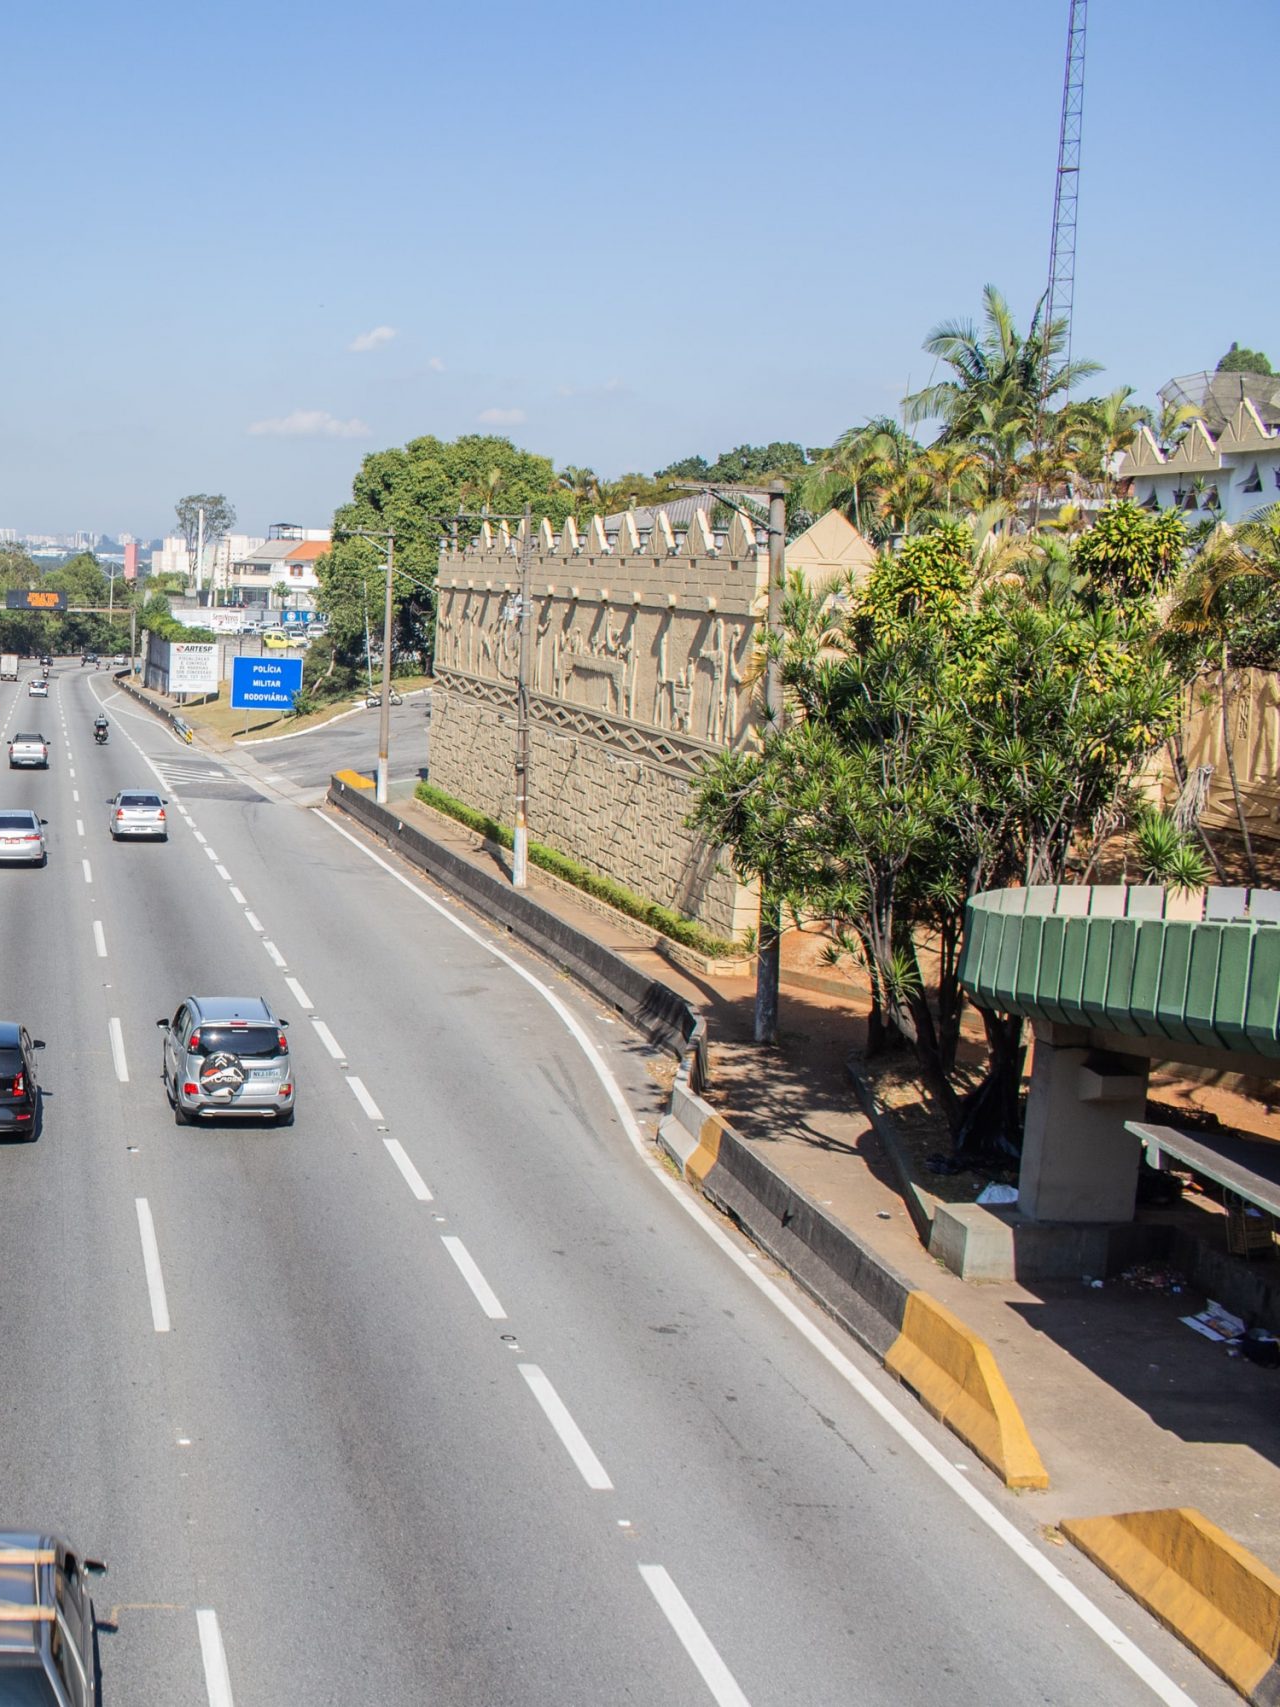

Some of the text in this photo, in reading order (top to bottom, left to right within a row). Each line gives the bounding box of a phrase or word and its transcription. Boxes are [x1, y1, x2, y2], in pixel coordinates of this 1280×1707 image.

[253, 664, 282, 673] POLÍCIA
[253, 680, 281, 688] MILITAR
[244, 693, 288, 702] RODOVIÁRIA
